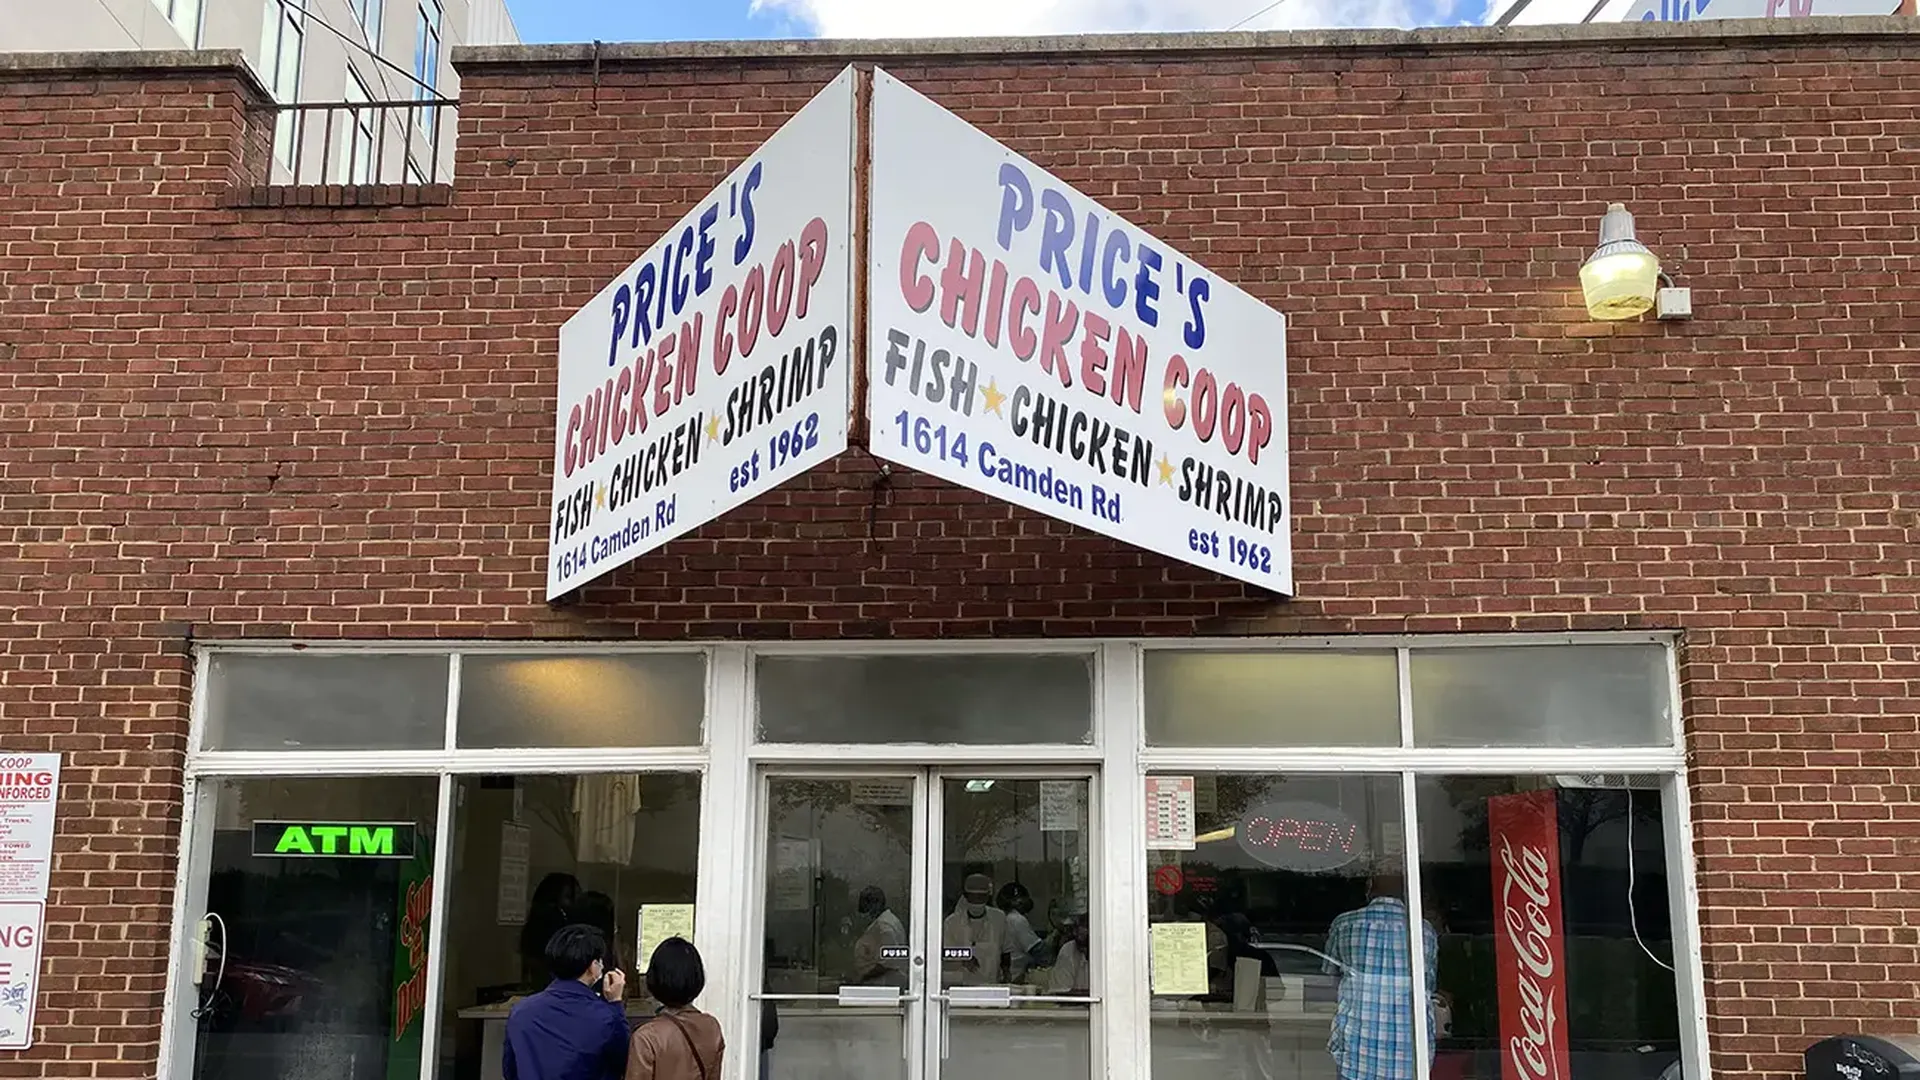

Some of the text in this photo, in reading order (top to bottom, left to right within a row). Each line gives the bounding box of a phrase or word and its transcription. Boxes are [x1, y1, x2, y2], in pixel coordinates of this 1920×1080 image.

[608, 161, 763, 367] PRICE'S
[996, 162, 1210, 350] PRICE'S
[563, 217, 828, 478] CHICKEN COOP
[900, 221, 1272, 465] CHICKEN COOP
[555, 325, 838, 545] FISH CHICKEN SHRIMP
[728, 412, 820, 493] est 1962
[884, 327, 1283, 535] FISH CHICKEN SHRIMP
[895, 409, 1122, 524] 1614 Camden Rd
[556, 492, 677, 582] 1614 Camden Rd
[1187, 526, 1272, 575] est 1962
[0, 757, 33, 769] COOP
[0, 772, 52, 786] ING
[274, 825, 394, 855] ATM
[1248, 816, 1356, 853] OPEN
[882, 949, 908, 957] PUSH
[944, 949, 970, 957] PUSH
[1500, 832, 1554, 1080] Coca-Cola
